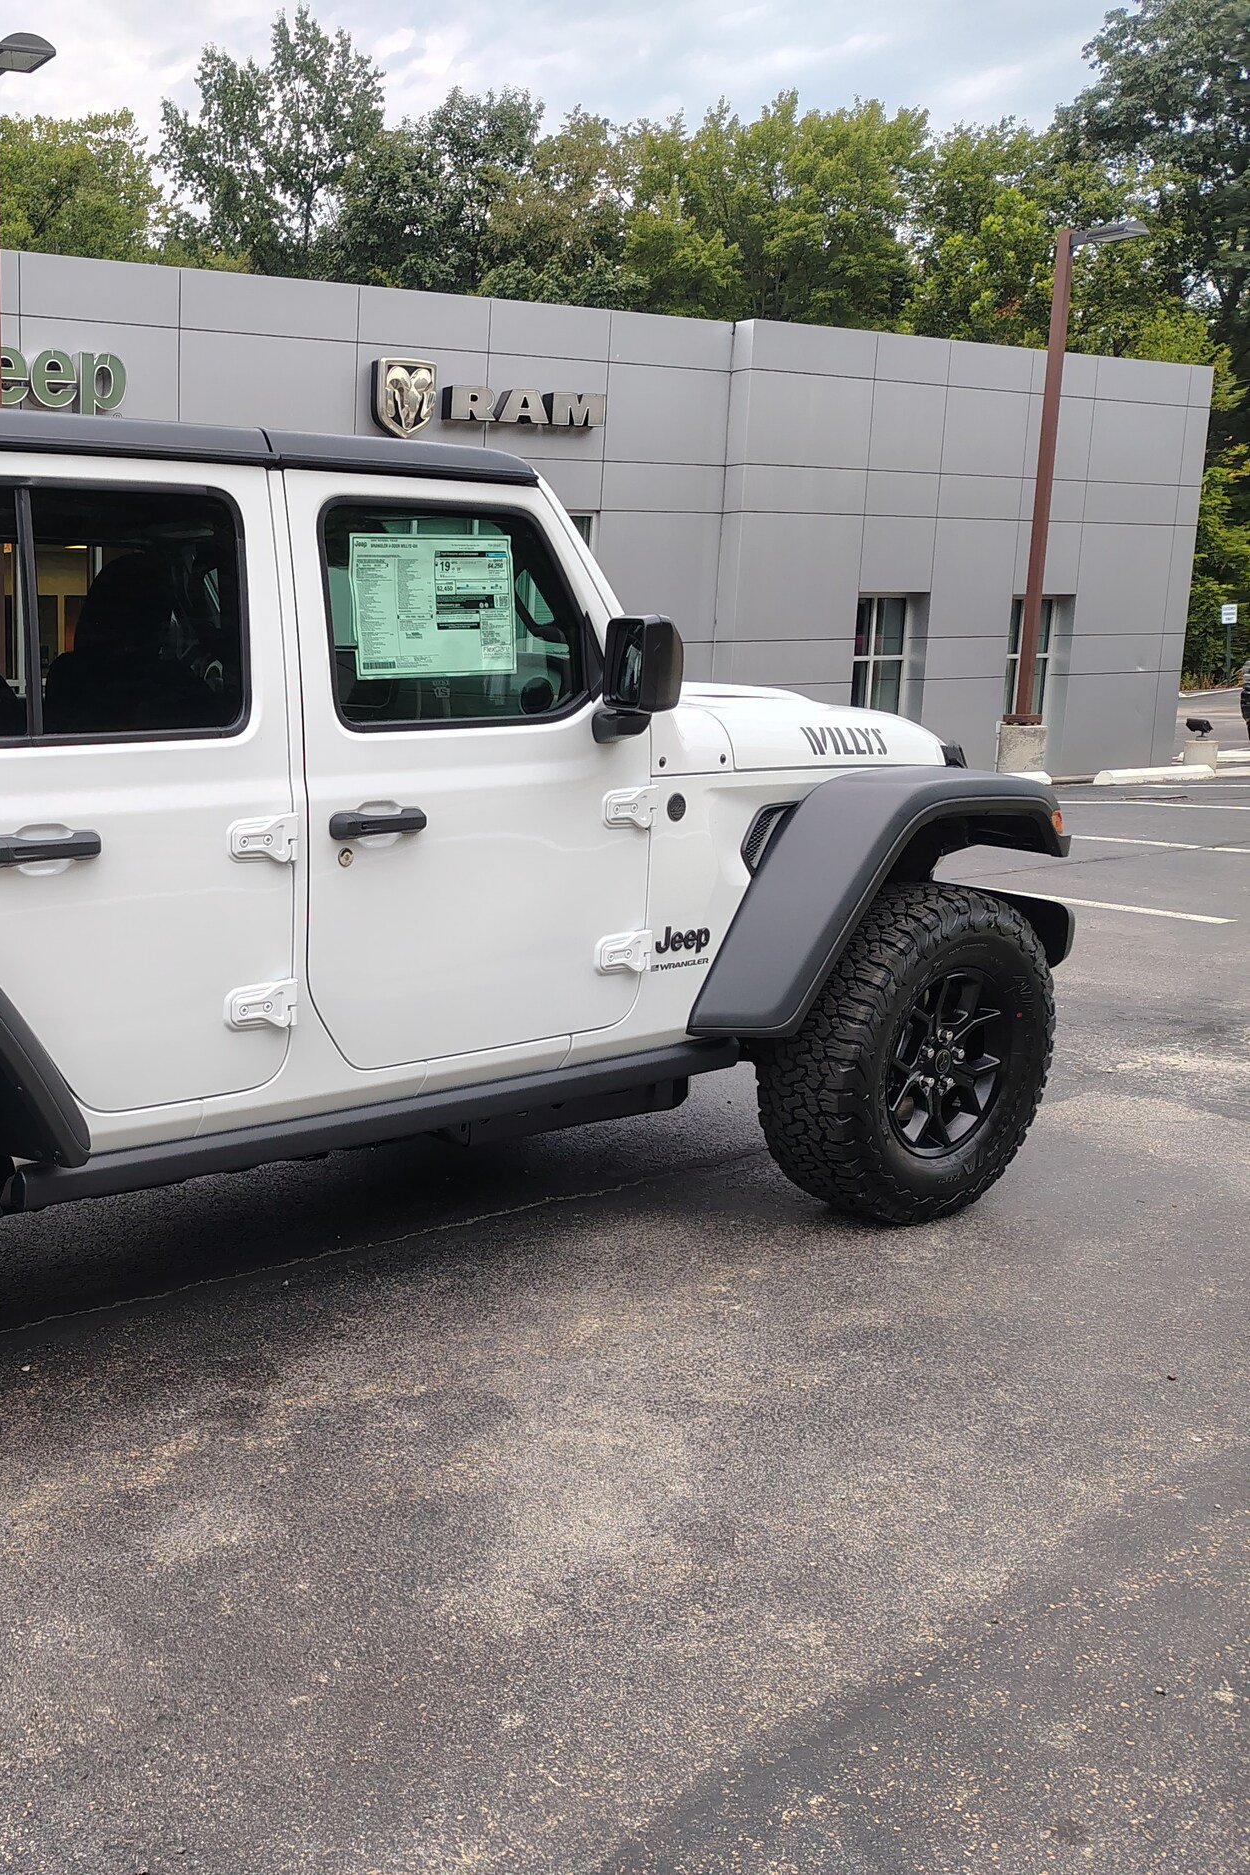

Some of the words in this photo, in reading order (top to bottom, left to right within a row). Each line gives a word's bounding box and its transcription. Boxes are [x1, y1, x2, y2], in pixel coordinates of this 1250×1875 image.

[442, 384, 608, 428] RAM
[440, 561, 450, 572] 19
[799, 726, 888, 756] WILLYS
[655, 926, 710, 954] Jeep
[660, 957, 709, 971] WRANGLER
